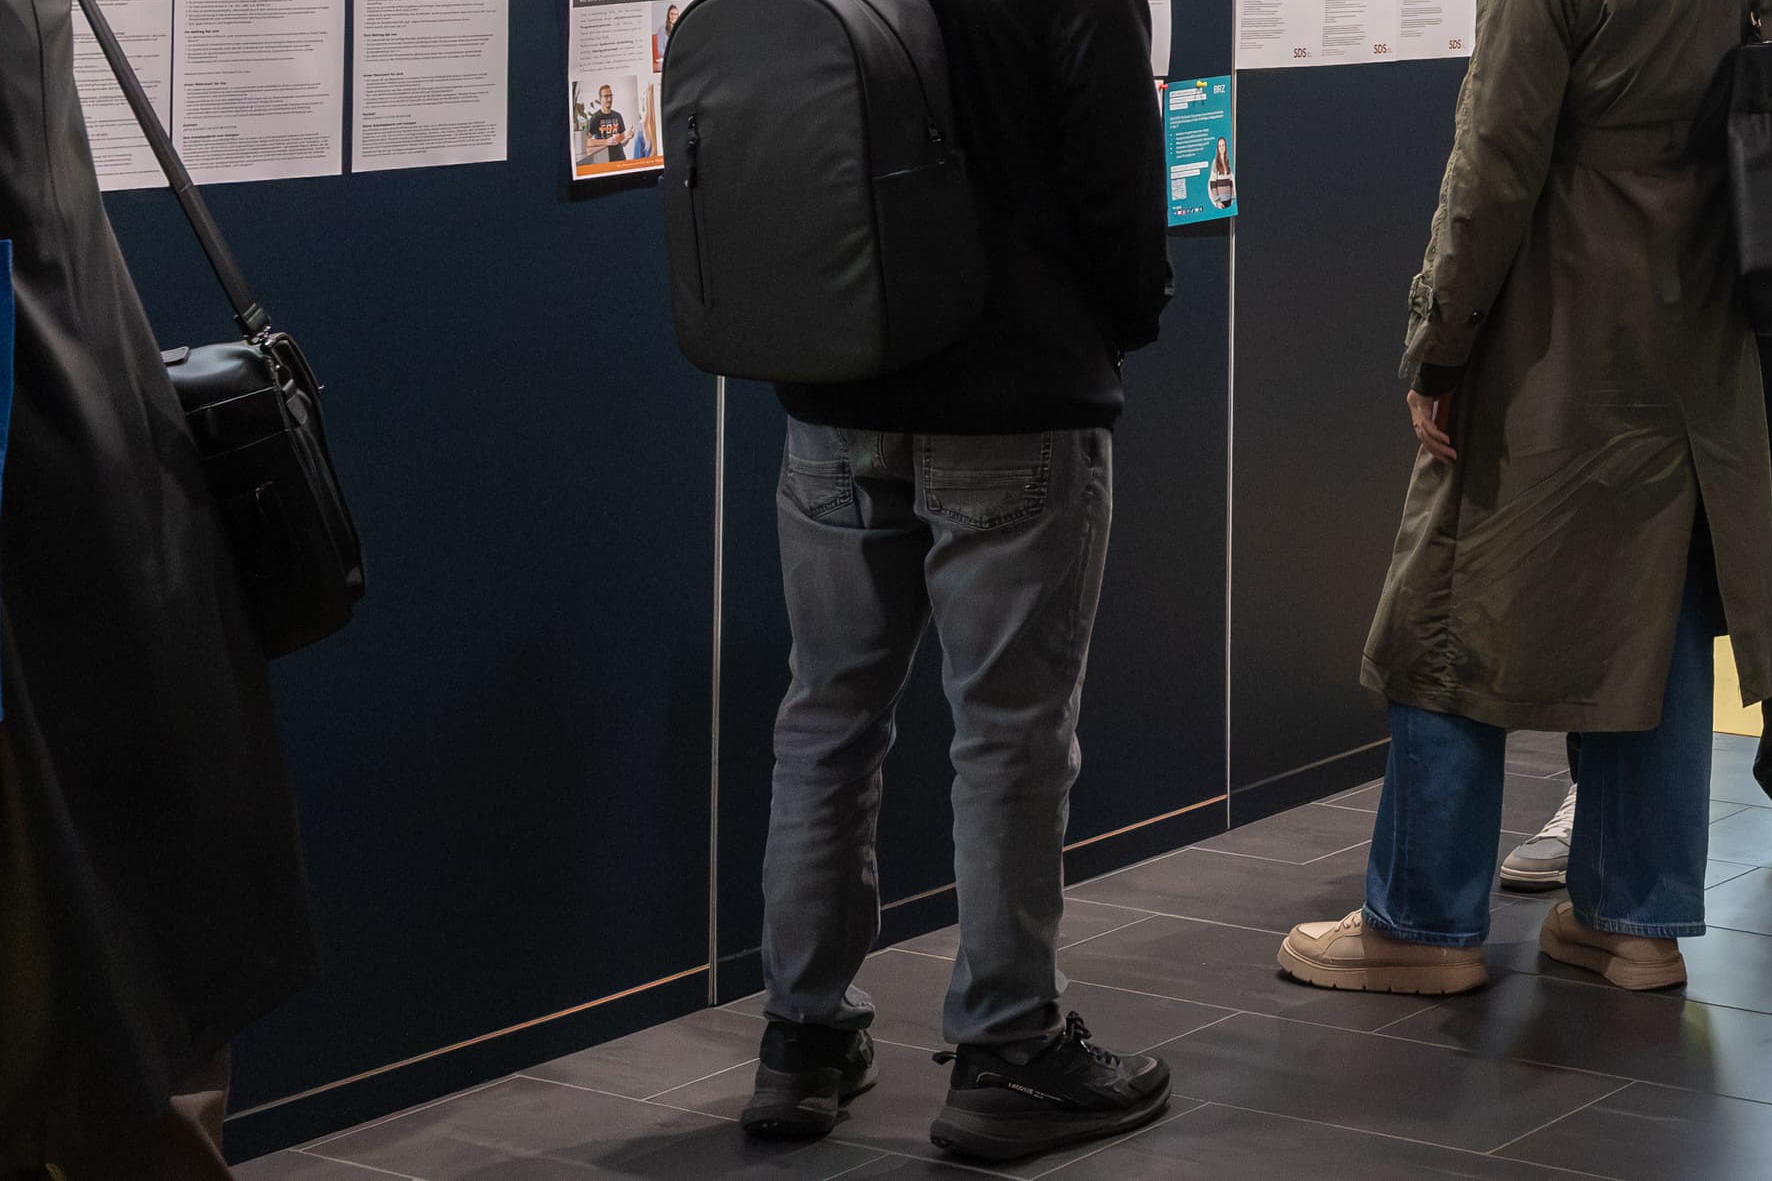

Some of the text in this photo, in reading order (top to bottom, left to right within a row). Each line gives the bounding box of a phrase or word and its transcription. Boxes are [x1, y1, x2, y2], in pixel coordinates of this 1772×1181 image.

[1373, 43, 1387, 55] SDS
[1448, 39, 1462, 50] SDS
[1293, 48, 1307, 59] SDS
[1213, 84, 1226, 94] BRZ
